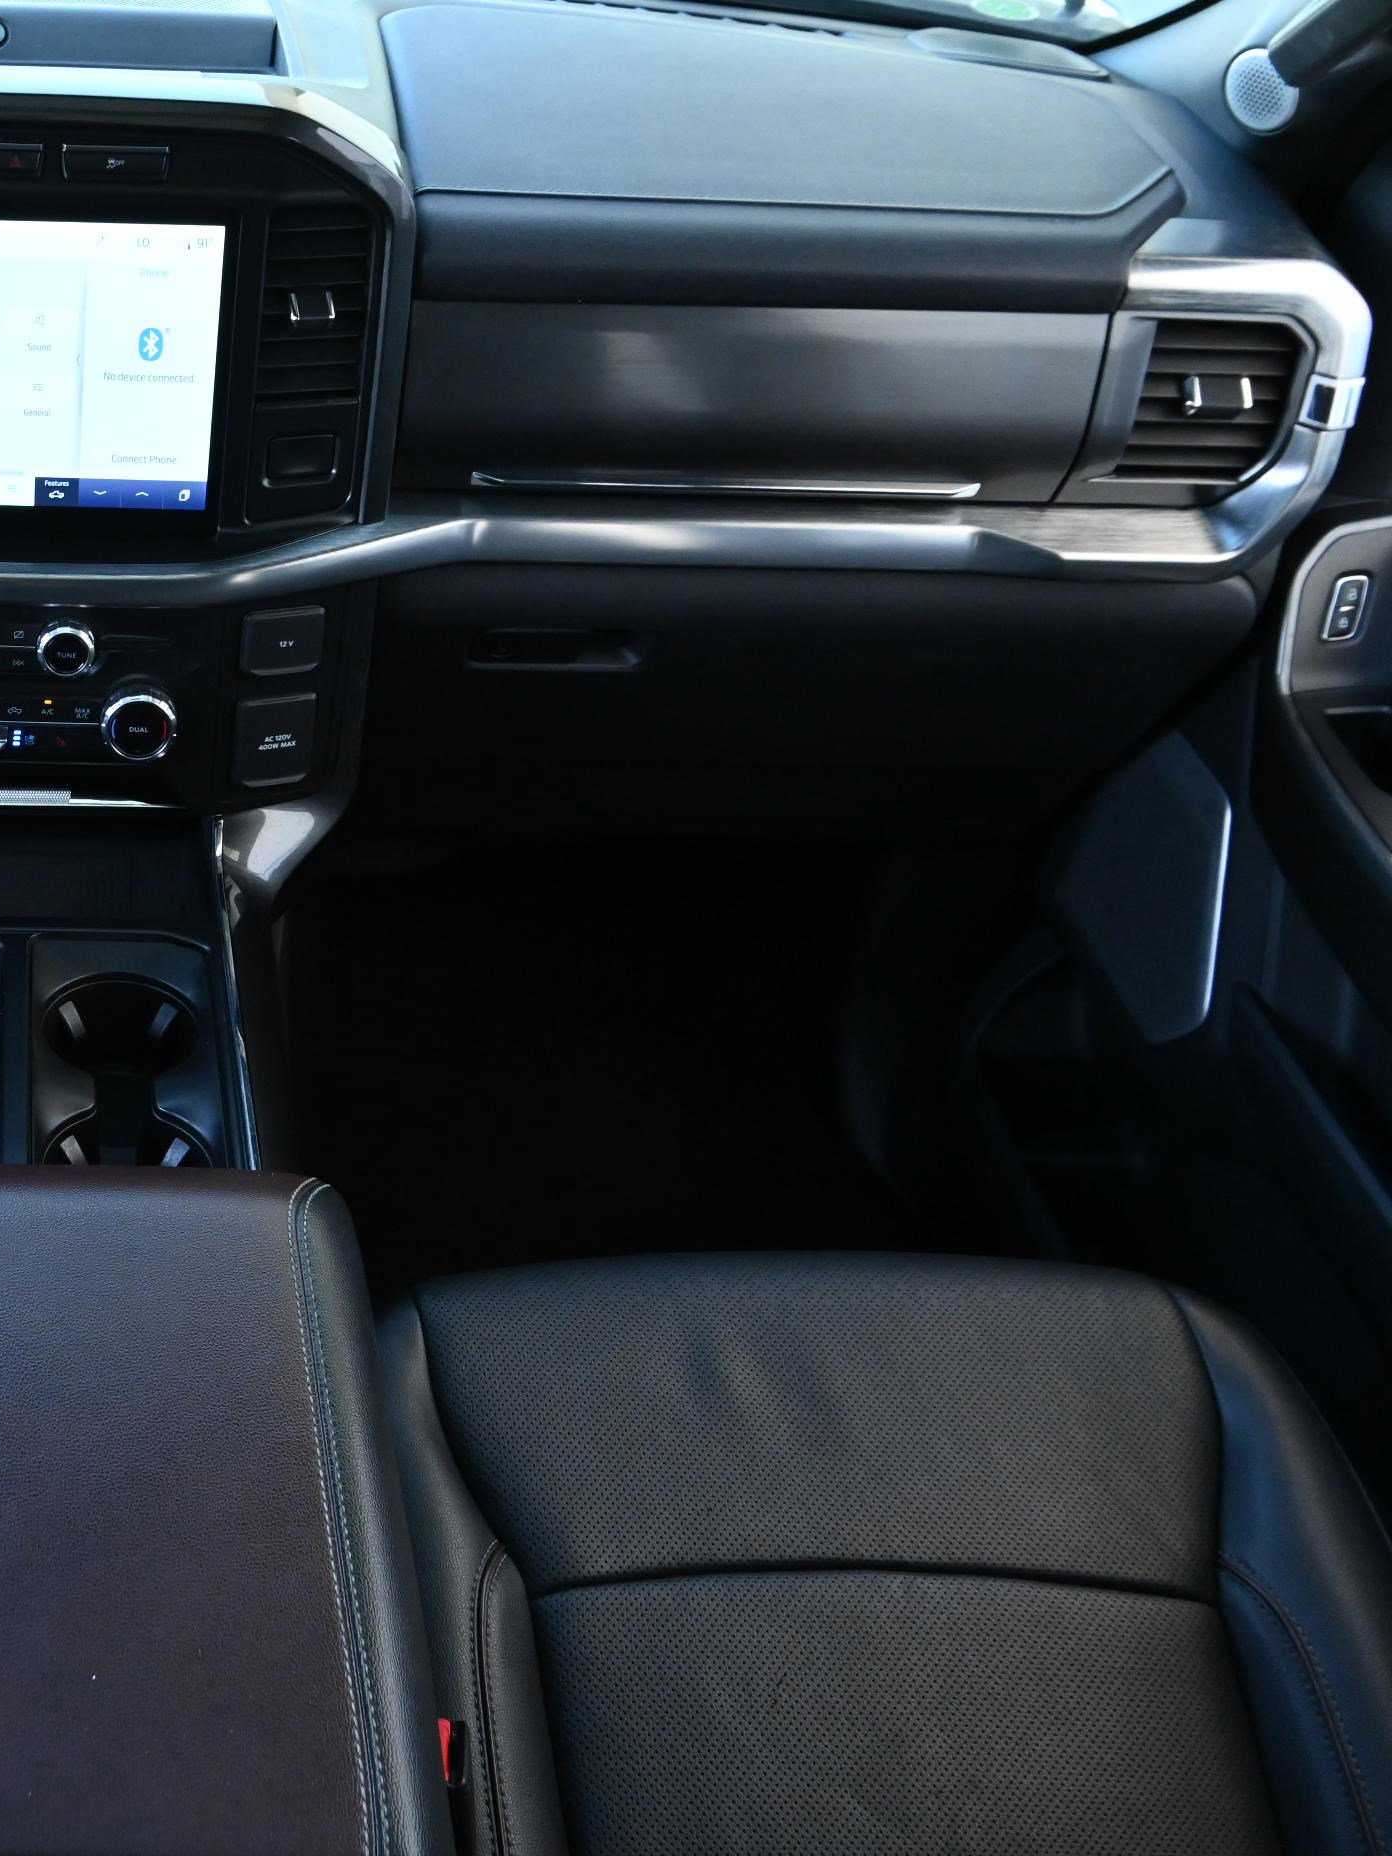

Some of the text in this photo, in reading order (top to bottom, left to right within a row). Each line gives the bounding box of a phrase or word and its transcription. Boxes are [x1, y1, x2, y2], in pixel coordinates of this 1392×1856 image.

[139, 267, 170, 279] Phone
[27, 342, 51, 351] Sound
[103, 371, 194, 383] No device connected
[23, 407, 51, 417] General
[111, 453, 177, 465] Connect Phone
[44, 479, 70, 488] Features
[57, 650, 78, 660] TUNE
[40, 706, 55, 716] A/C
[74, 706, 91, 714] MAX
[128, 724, 150, 735] DUAL
[275, 733, 292, 742] 120V
[258, 740, 296, 751] 400W MAX
